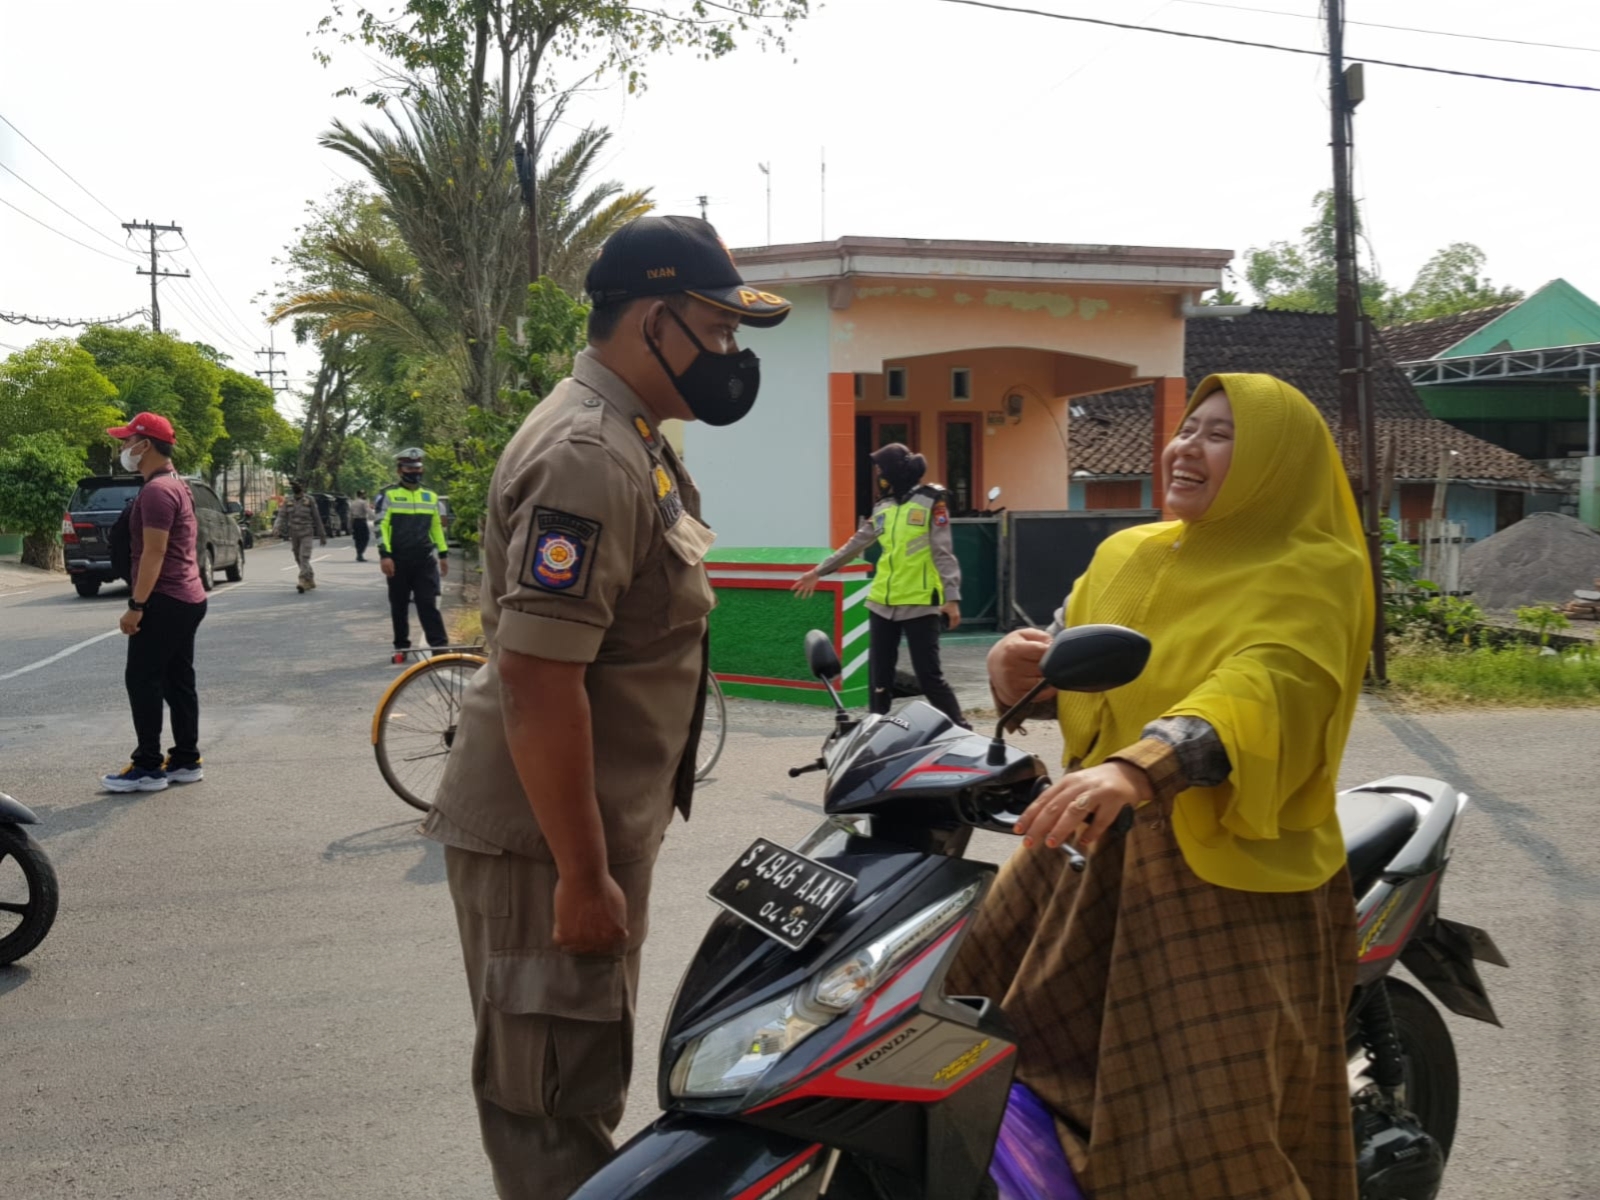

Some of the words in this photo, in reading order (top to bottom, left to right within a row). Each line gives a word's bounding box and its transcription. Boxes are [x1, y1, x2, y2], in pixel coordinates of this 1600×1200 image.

[646, 266, 676, 279] IVAN
[741, 845, 766, 867] S
[755, 852, 804, 889] 4946
[855, 1026, 918, 1071] HONDA
